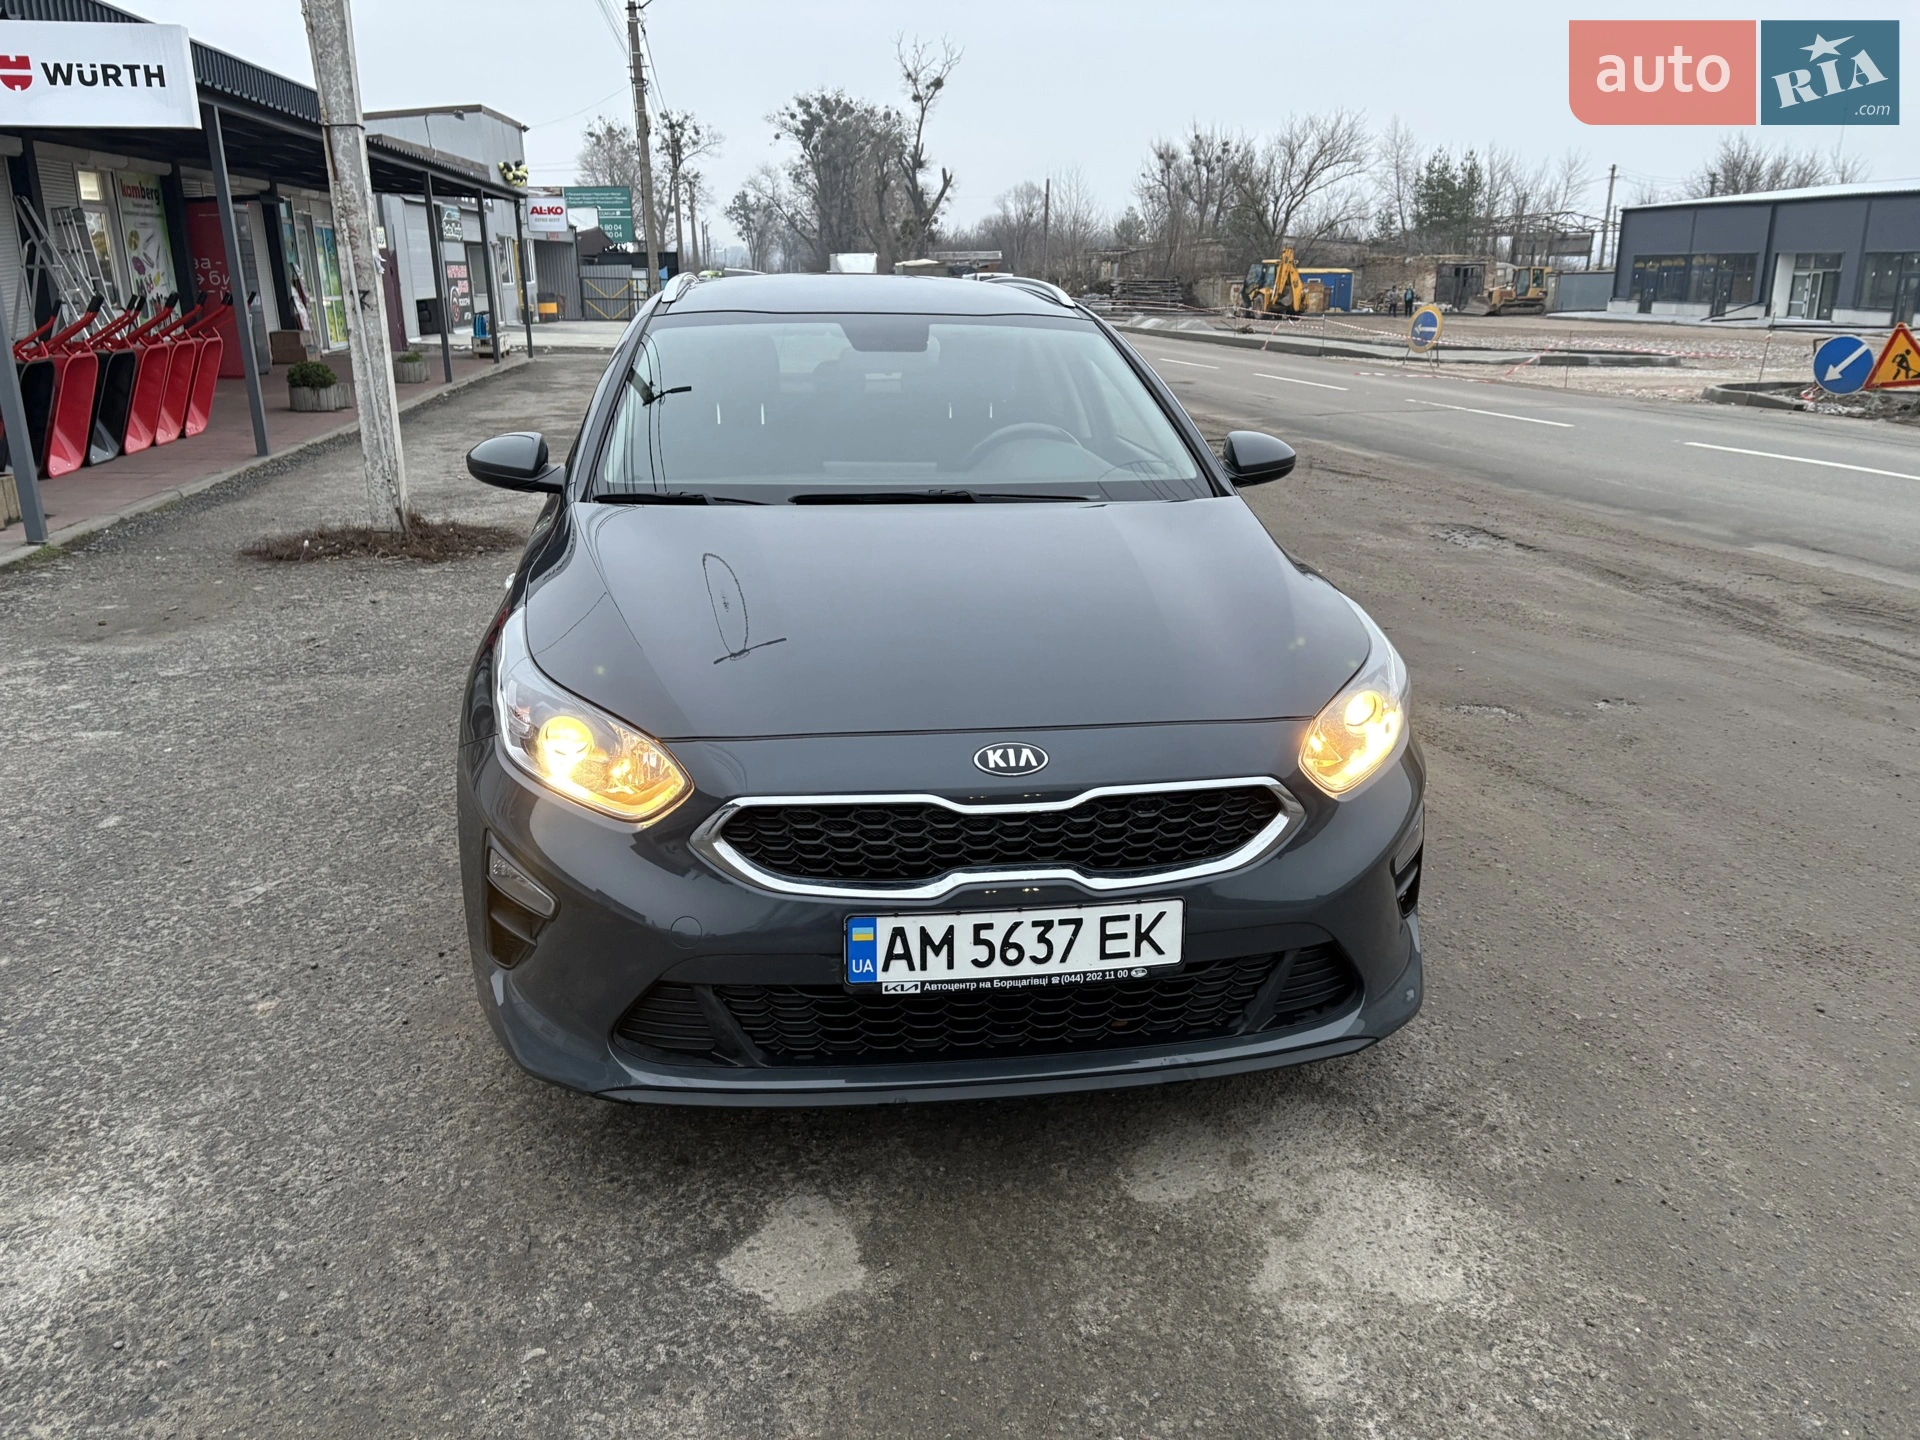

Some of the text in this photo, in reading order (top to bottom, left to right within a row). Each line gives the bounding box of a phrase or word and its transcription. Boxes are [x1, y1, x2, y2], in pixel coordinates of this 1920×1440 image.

[40, 62, 166, 87] WÜRTH
[986, 748, 1039, 768] KIA
[881, 911, 1167, 972] AM 5637 EK
[851, 959, 874, 973] UA
[924, 981, 977, 992] Автоцентр
[979, 981, 991, 989] на
[993, 976, 1048, 988] Борщагівці
[1060, 973, 1084, 984] (044)
[1086, 972, 1102, 981] 202
[1105, 971, 1114, 980] 11
[1117, 970, 1128, 979] 00
